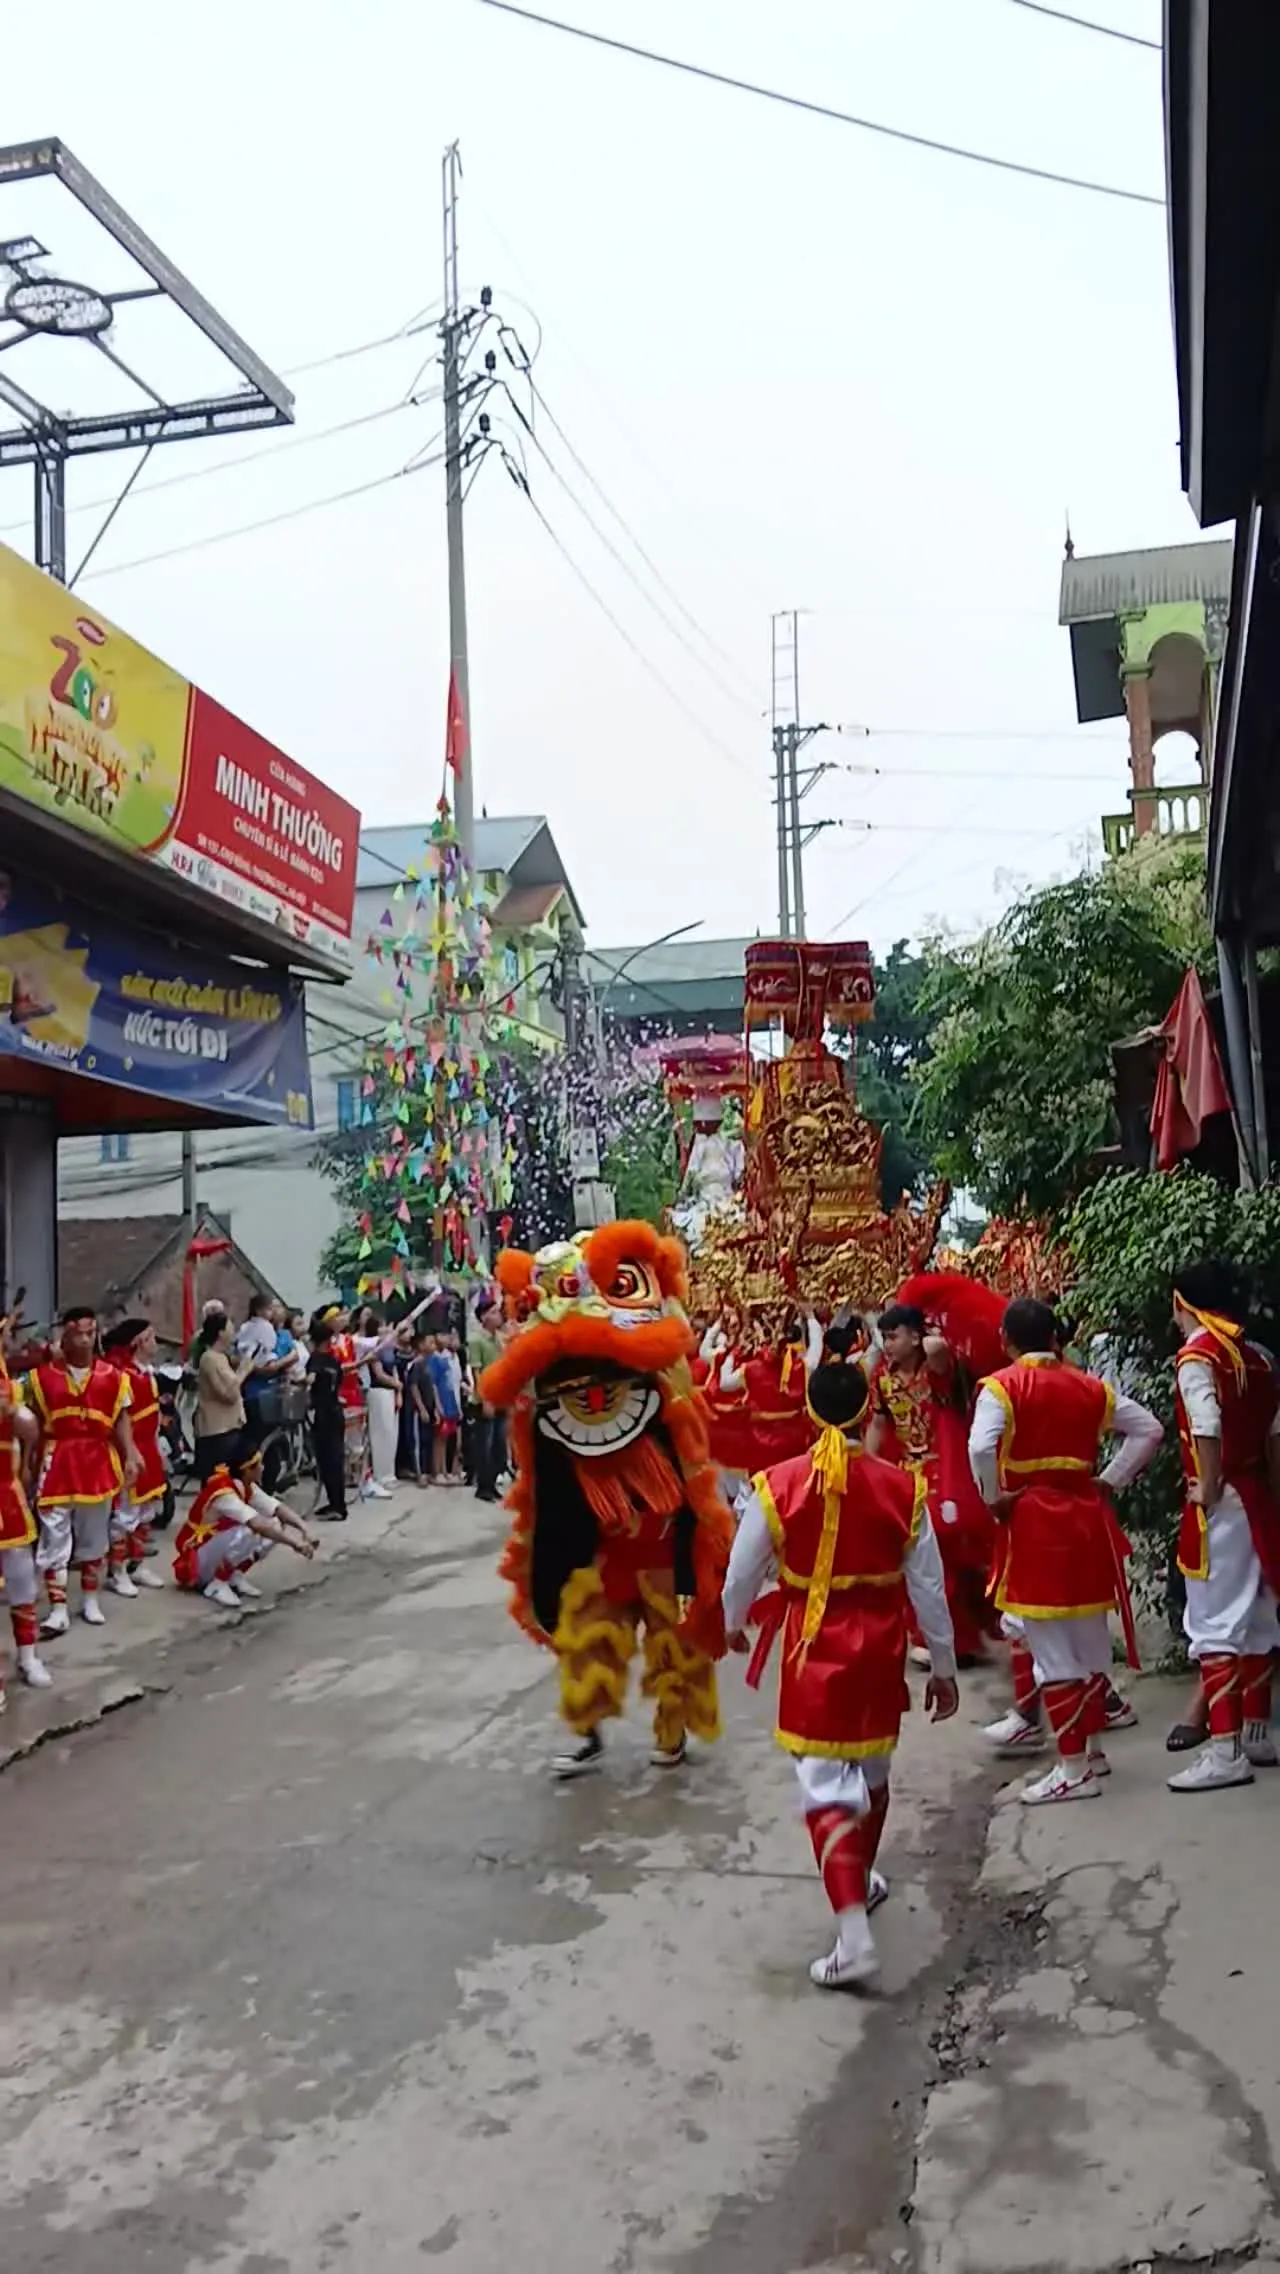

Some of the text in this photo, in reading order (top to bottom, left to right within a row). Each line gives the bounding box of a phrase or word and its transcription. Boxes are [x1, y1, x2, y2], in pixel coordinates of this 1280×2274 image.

[215, 754, 270, 824] MINH
[272, 793, 344, 872] THƯỞNG
[124, 1010, 164, 1047] HÚC
[164, 1017, 199, 1056] TỚI
[202, 1029, 229, 1062] ĐI
